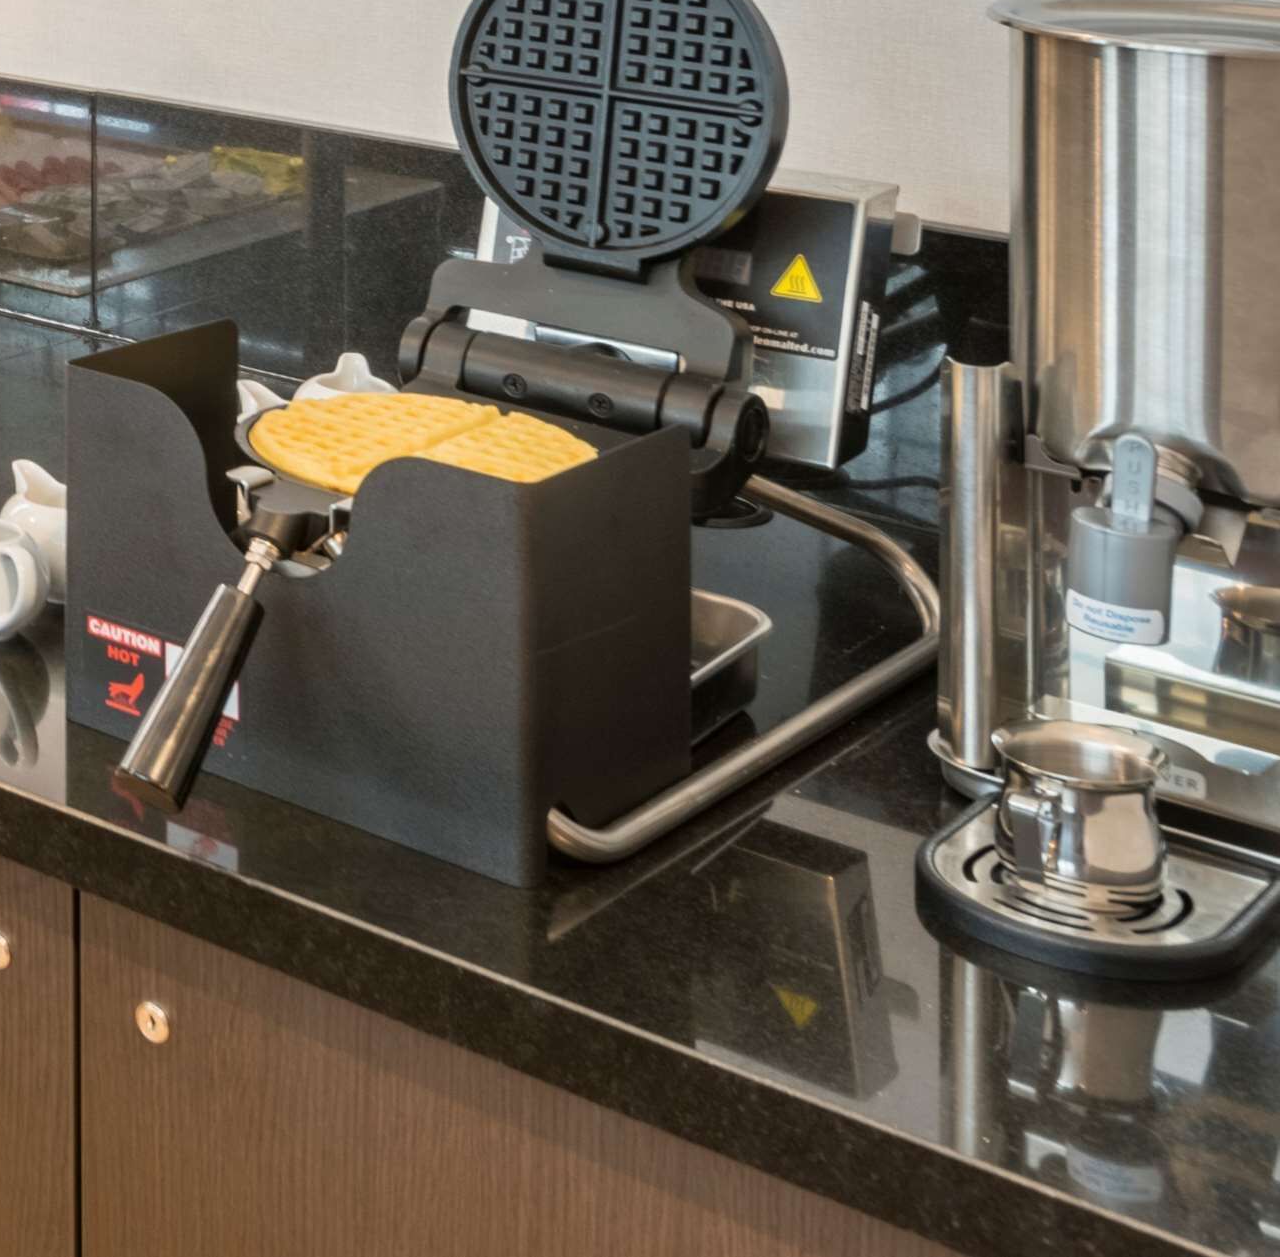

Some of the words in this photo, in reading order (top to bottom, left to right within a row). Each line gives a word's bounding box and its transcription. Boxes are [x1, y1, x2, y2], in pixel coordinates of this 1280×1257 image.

[1125, 442, 1143, 511] PUSH
[88, 618, 160, 654] CAUTION
[107, 645, 140, 667] HOT
